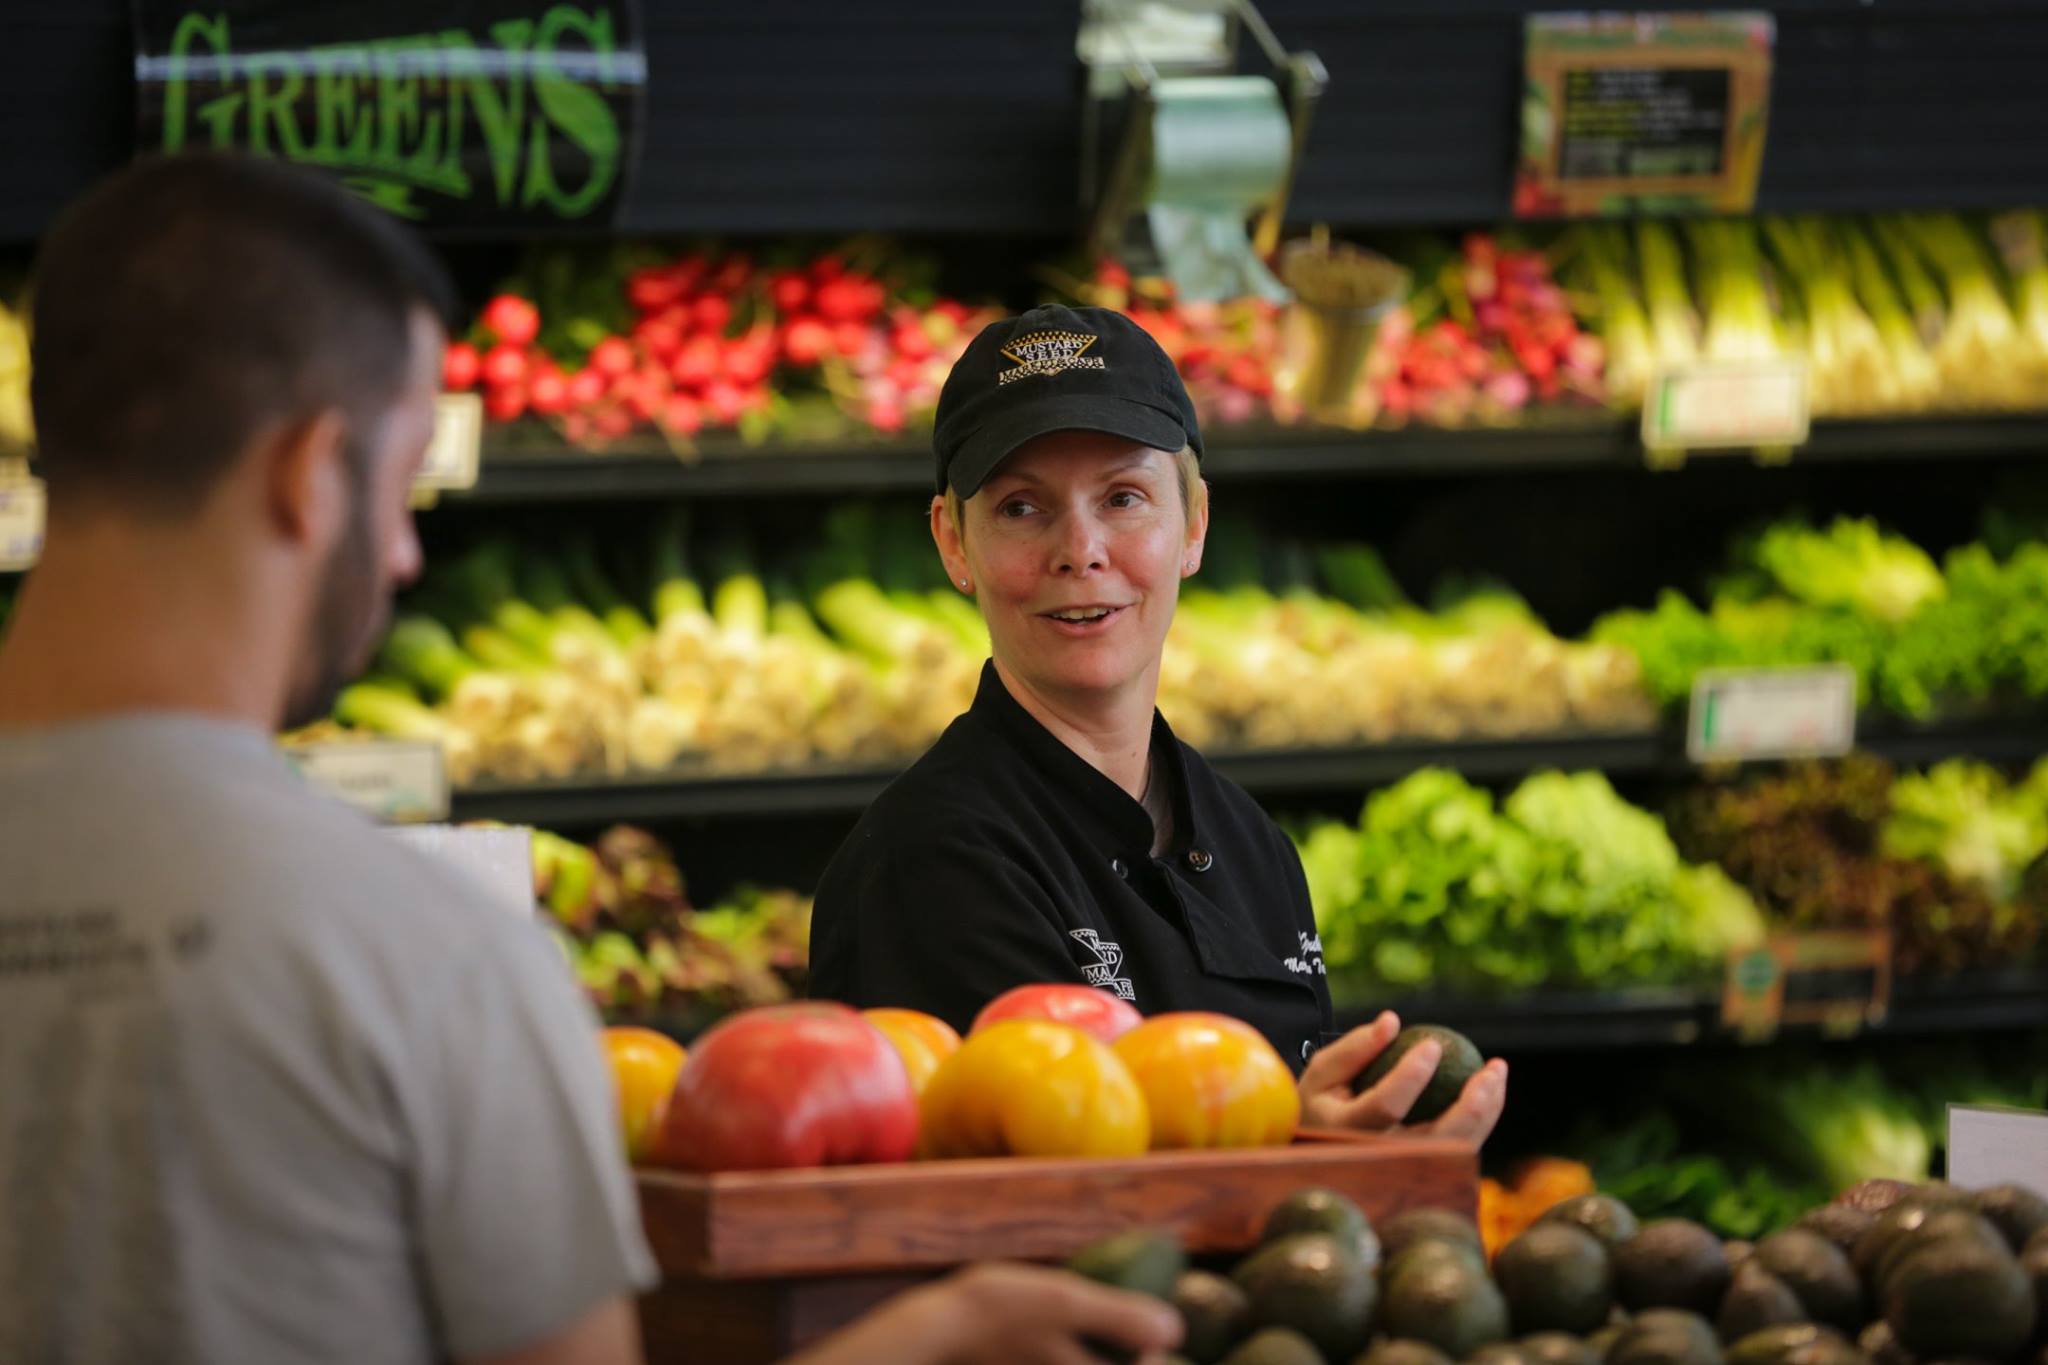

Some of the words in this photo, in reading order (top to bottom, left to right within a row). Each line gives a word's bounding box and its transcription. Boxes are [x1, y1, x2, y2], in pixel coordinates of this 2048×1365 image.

[162, 5, 622, 219] GREENS
[1015, 340, 1083, 357] MUSTARD
[1025, 349, 1074, 360] SEED
